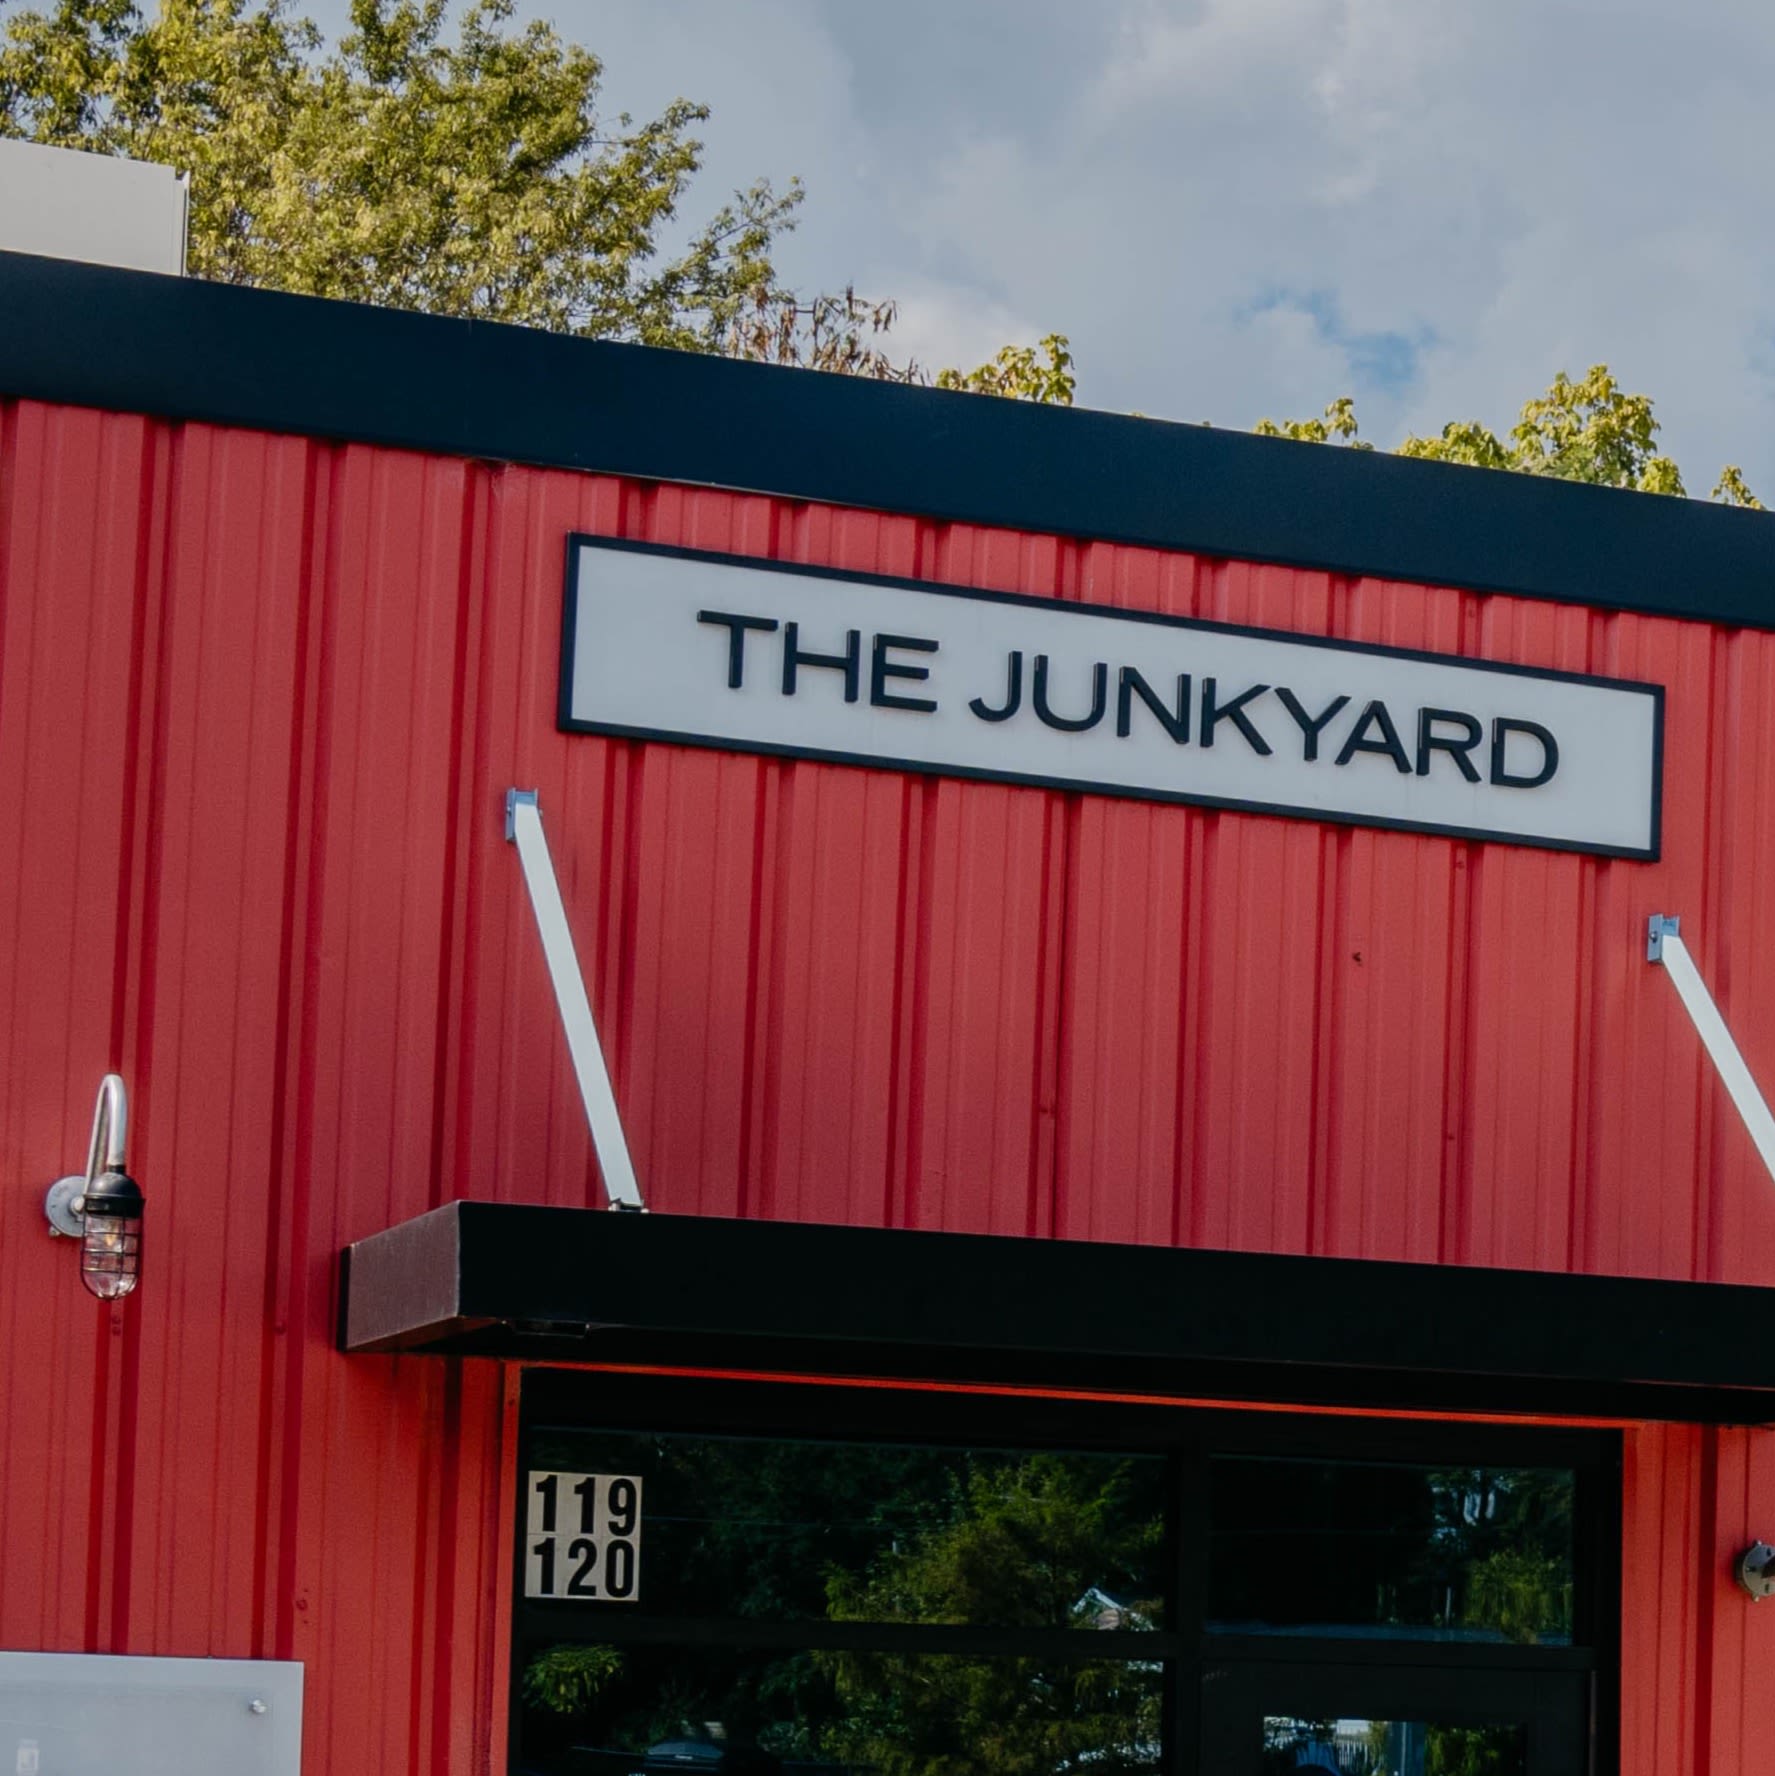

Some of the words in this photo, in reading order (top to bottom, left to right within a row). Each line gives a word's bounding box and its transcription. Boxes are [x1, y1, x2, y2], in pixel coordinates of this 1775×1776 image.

[696, 609, 940, 713] THE
[968, 650, 1560, 790] JUNKYARD
[534, 1474, 638, 1538] 119
[532, 1537, 636, 1598] 120
